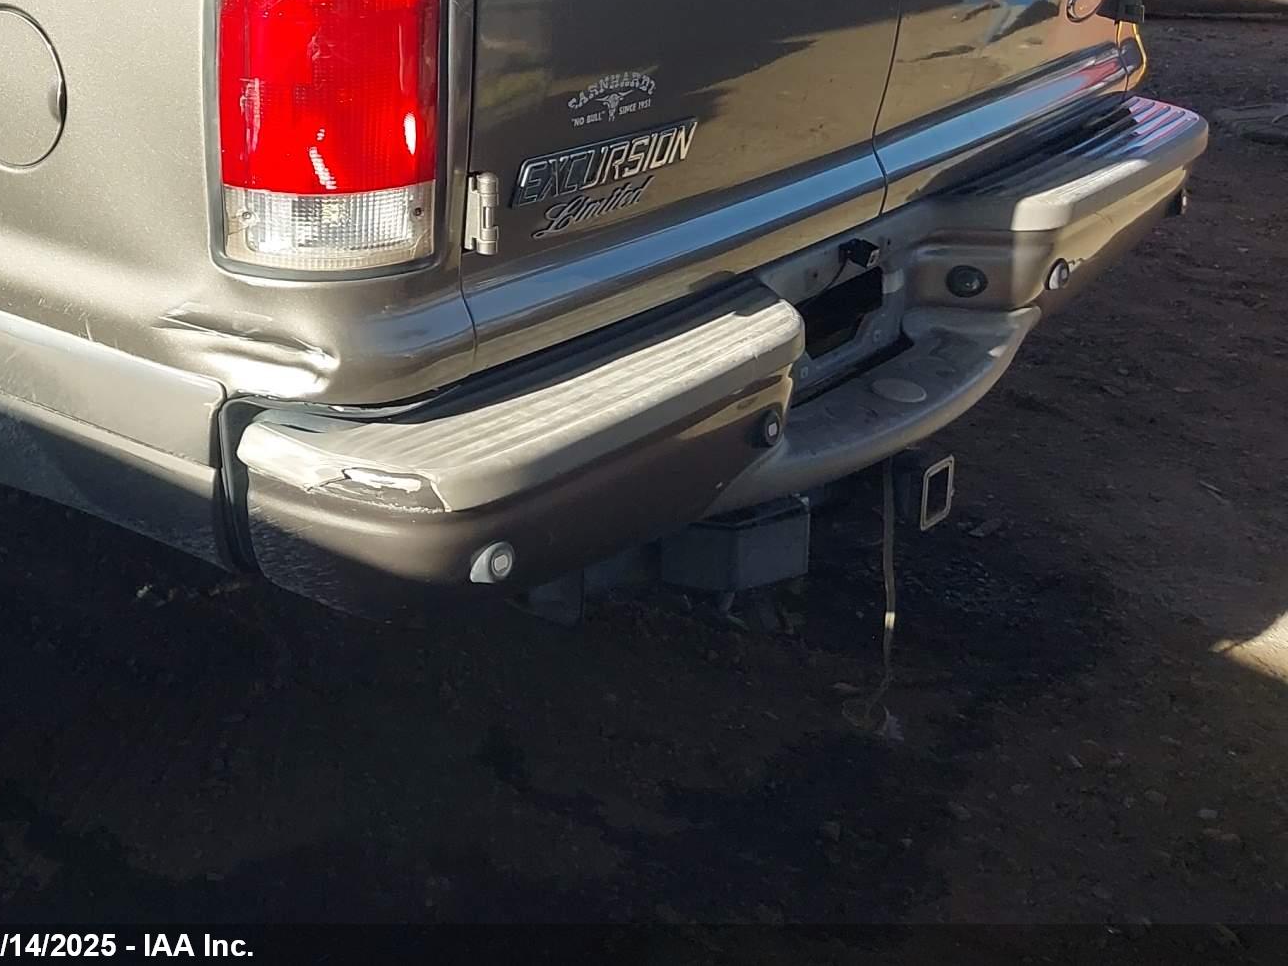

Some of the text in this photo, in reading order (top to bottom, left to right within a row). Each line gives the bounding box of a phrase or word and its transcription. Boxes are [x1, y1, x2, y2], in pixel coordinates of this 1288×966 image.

[619, 102, 636, 115] SINCE
[517, 121, 698, 206] EXCURSION
[532, 175, 655, 240] Limited
